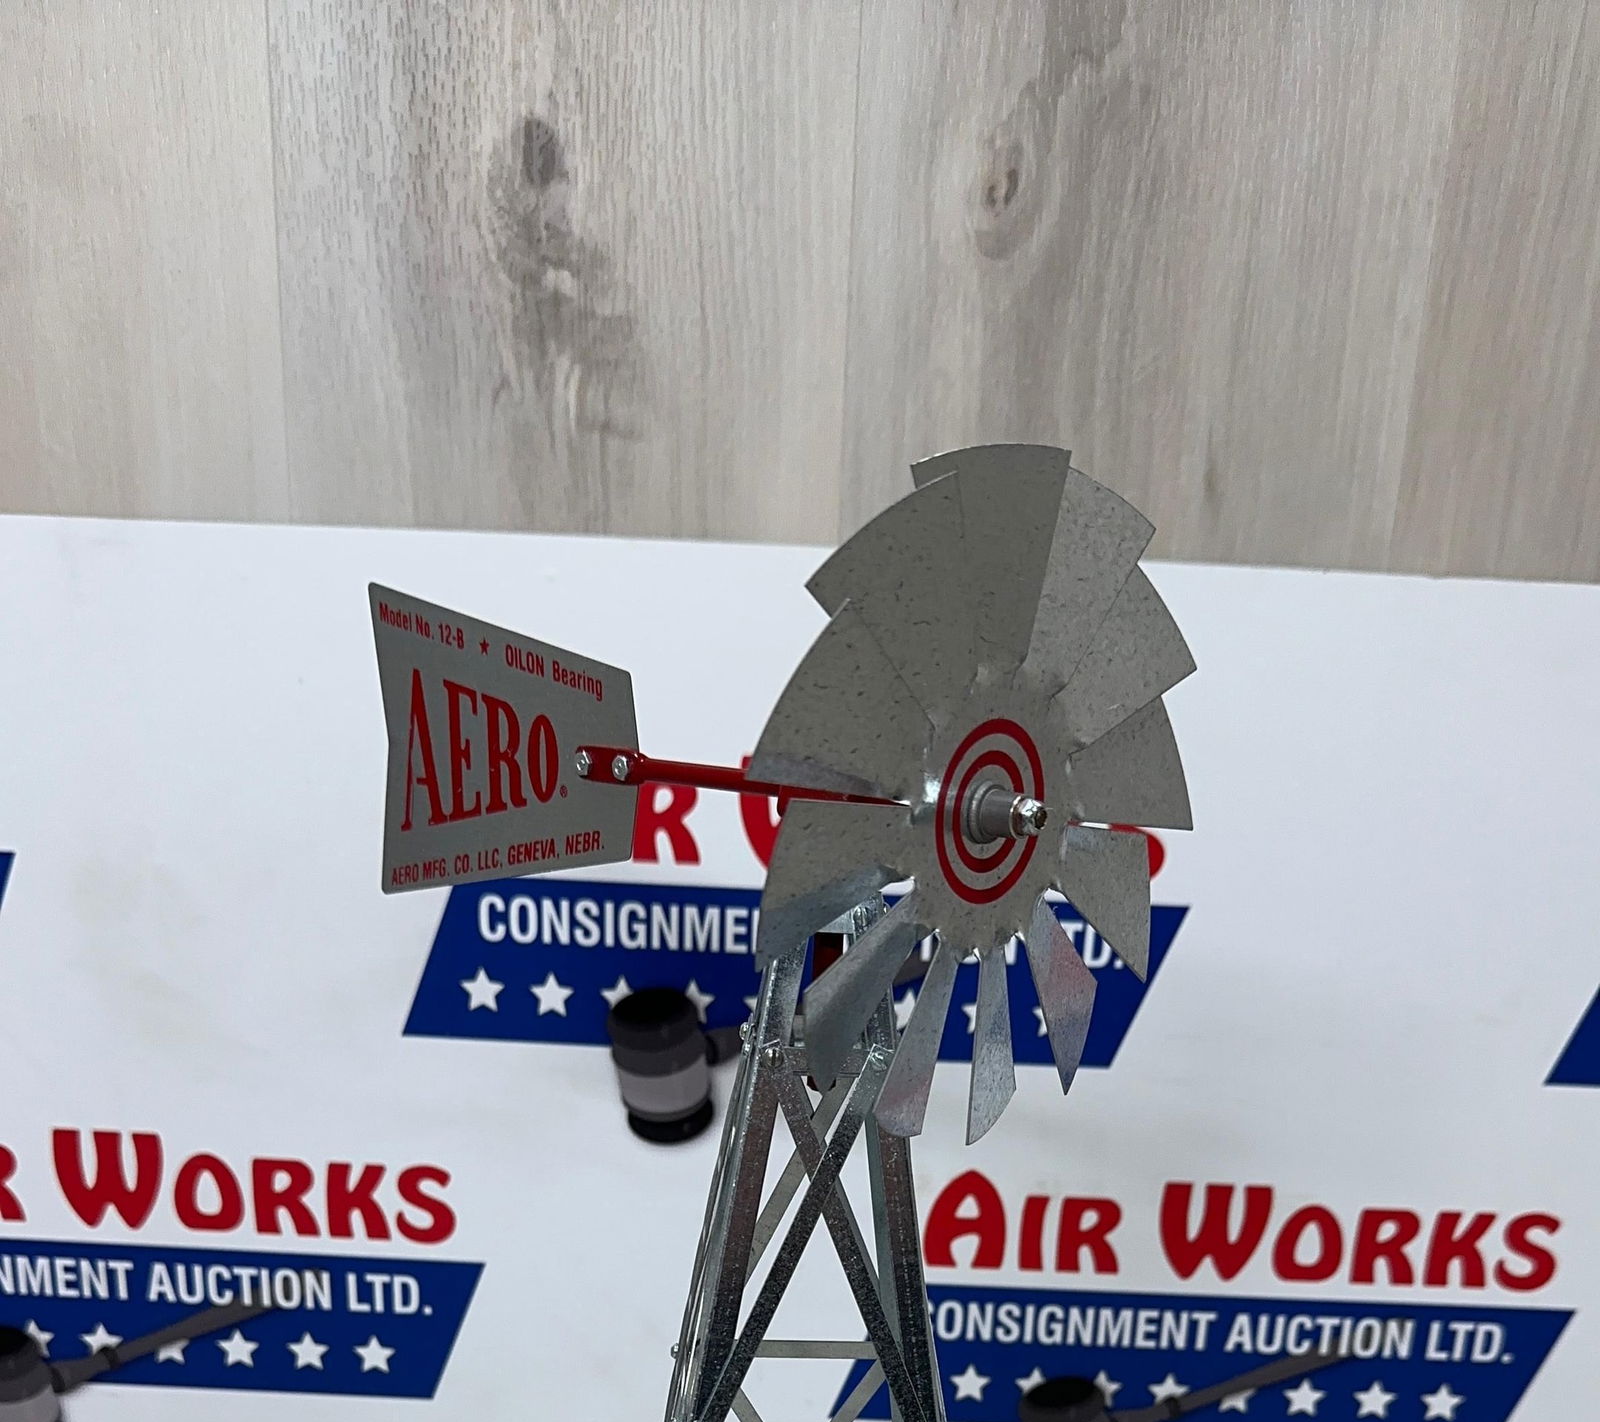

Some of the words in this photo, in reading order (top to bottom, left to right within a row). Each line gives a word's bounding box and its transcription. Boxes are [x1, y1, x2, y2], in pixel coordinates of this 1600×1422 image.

[379, 601, 412, 632] Model
[415, 614, 435, 640] No.
[438, 623, 465, 650] 12-B
[505, 644, 544, 678] OILON
[552, 660, 603, 701] Bearing
[391, 865, 419, 886] AERO
[423, 859, 450, 880] MFG.
[454, 854, 474, 875] CO.
[507, 838, 560, 866] GENEVA,
[565, 830, 605, 856] NEBR.
[478, 891, 759, 955] CONSIGNME
[52, 1127, 457, 1245] WORKS
[1159, 1181, 1562, 1291] WORKS
[148, 1263, 332, 1312] AUCTION
[346, 1271, 433, 1316] LTD.
[929, 1299, 1216, 1353] ONSIGNMENT
[1223, 1314, 1414, 1360] AUCTION
[1425, 1320, 1515, 1365] LTD.
